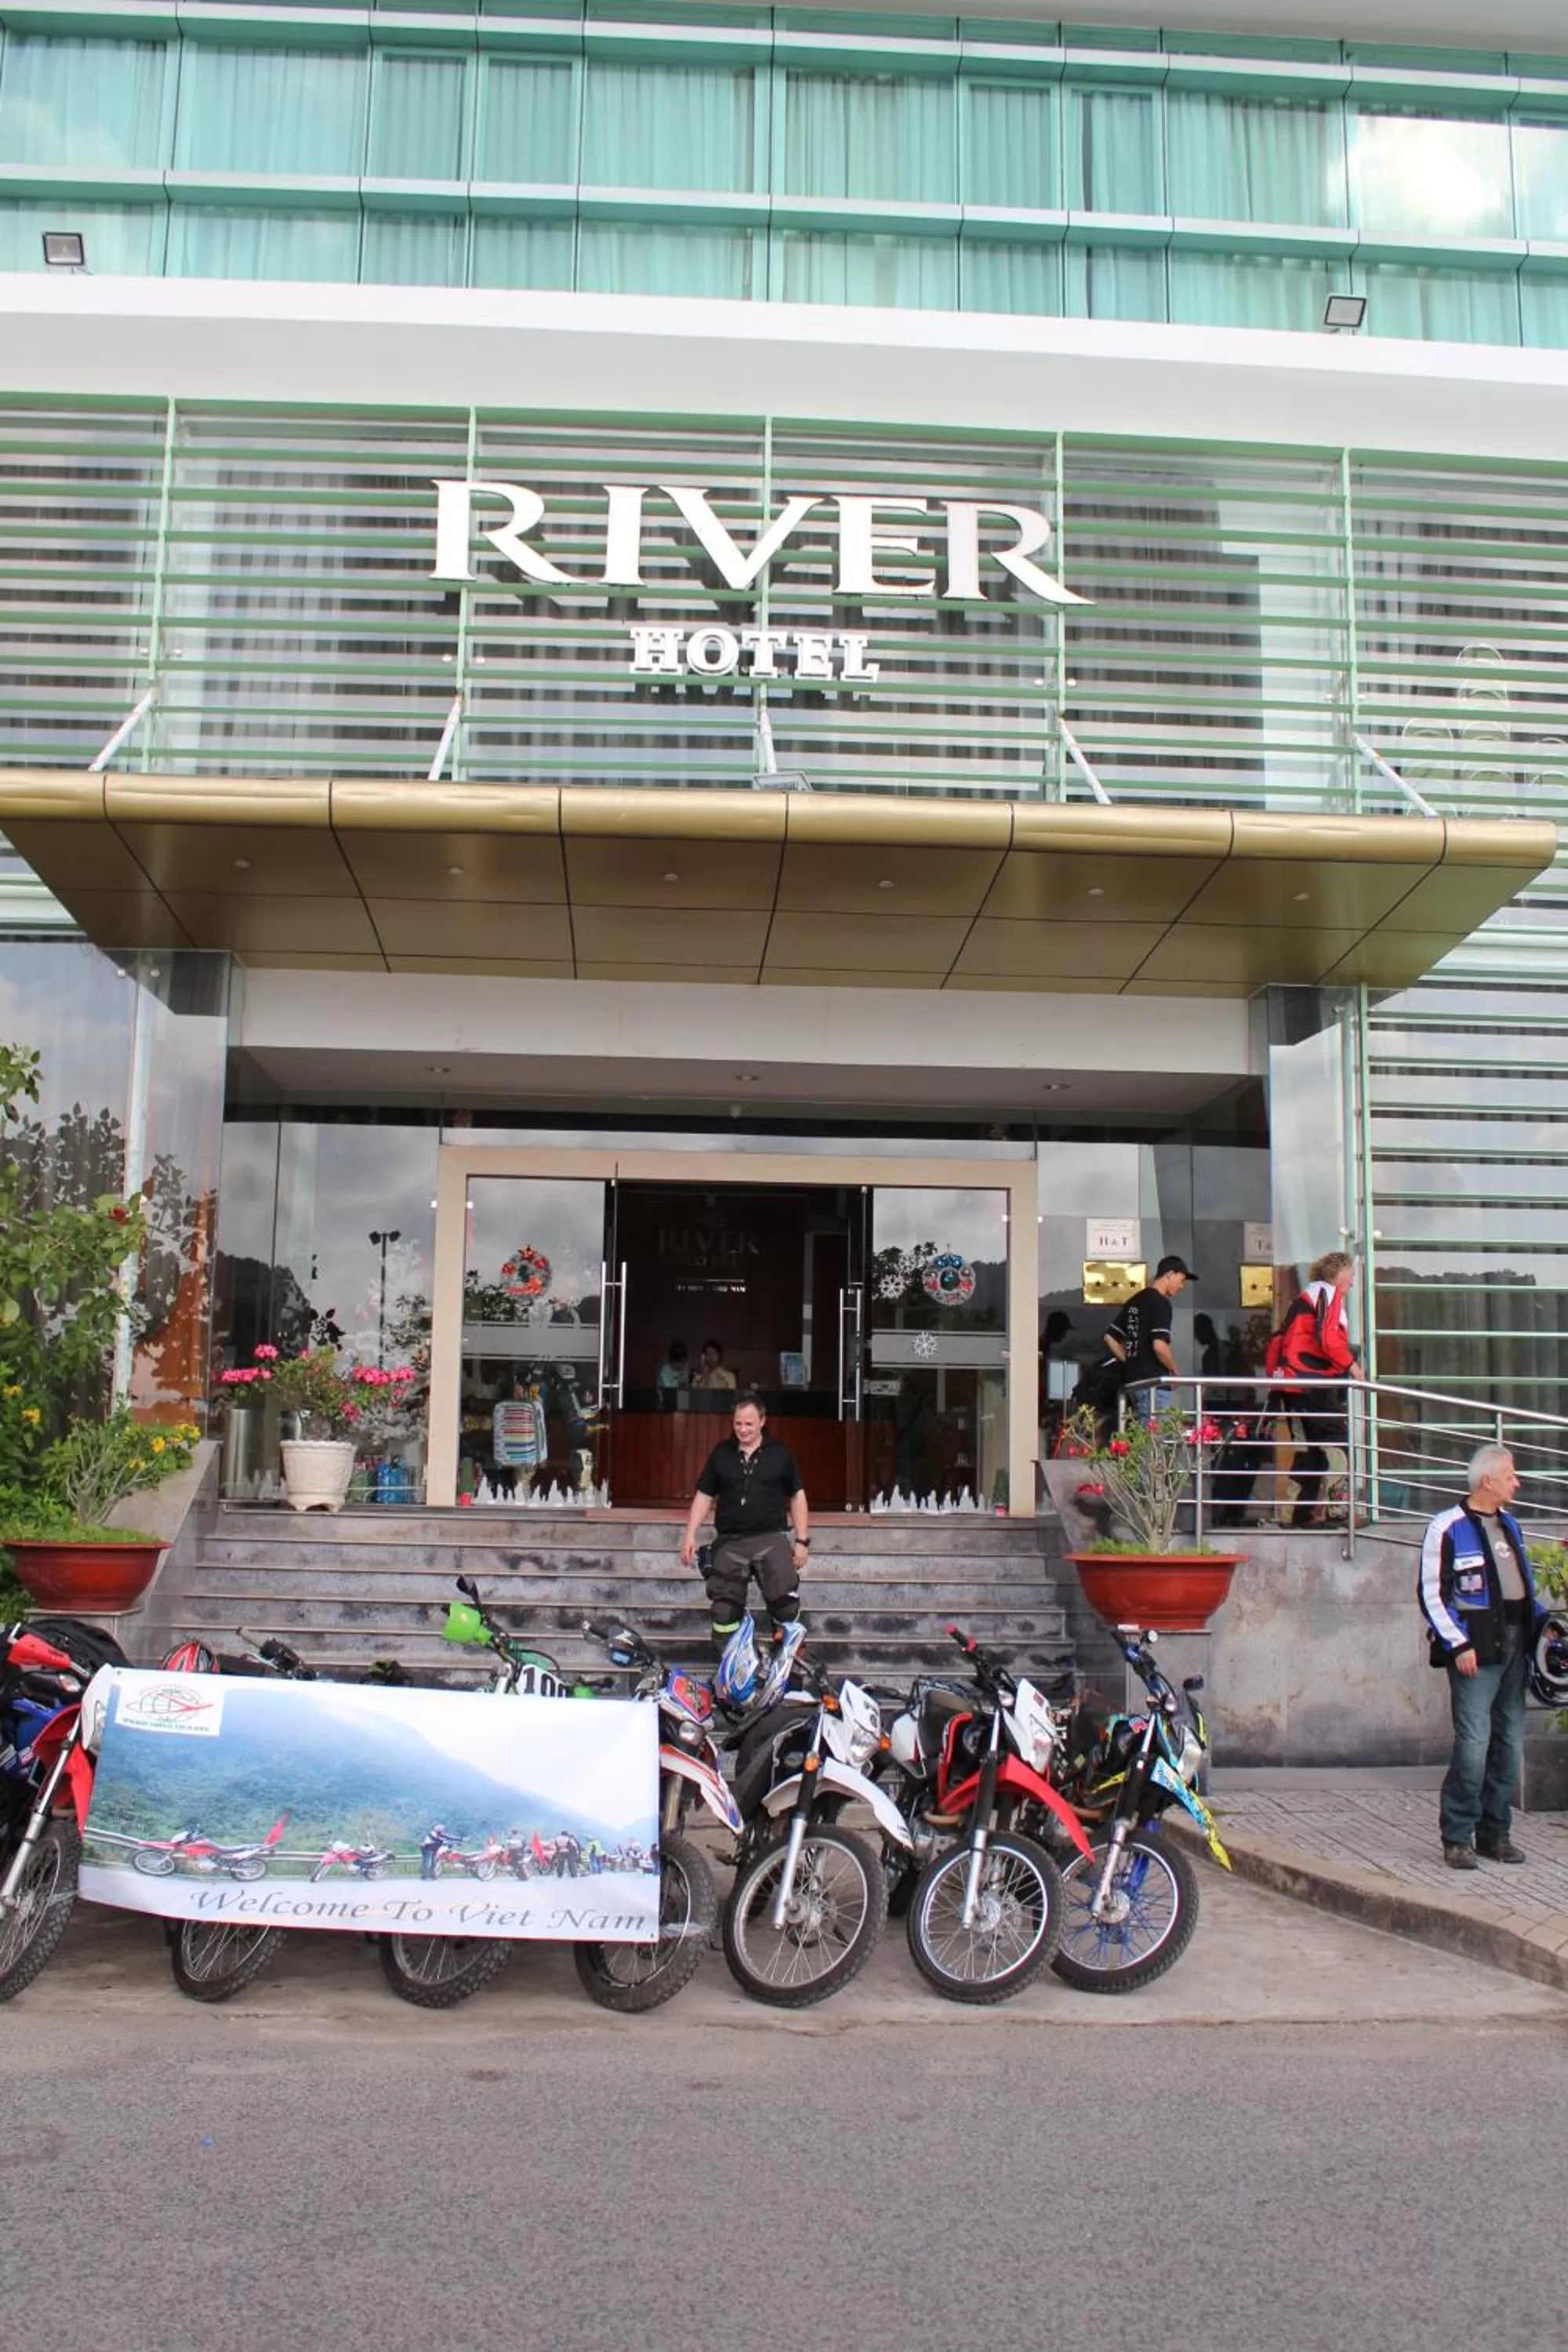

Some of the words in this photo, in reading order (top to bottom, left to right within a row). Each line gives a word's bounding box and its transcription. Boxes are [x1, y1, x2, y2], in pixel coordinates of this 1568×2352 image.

[429, 479, 1096, 605] RIVER
[630, 627, 880, 683] HOTEL
[659, 1228, 761, 1255] RIVER
[190, 1889, 371, 1918] Welcome
[383, 1899, 434, 1921] To
[449, 1902, 533, 1926] Viet
[546, 1908, 646, 1931] Nam
